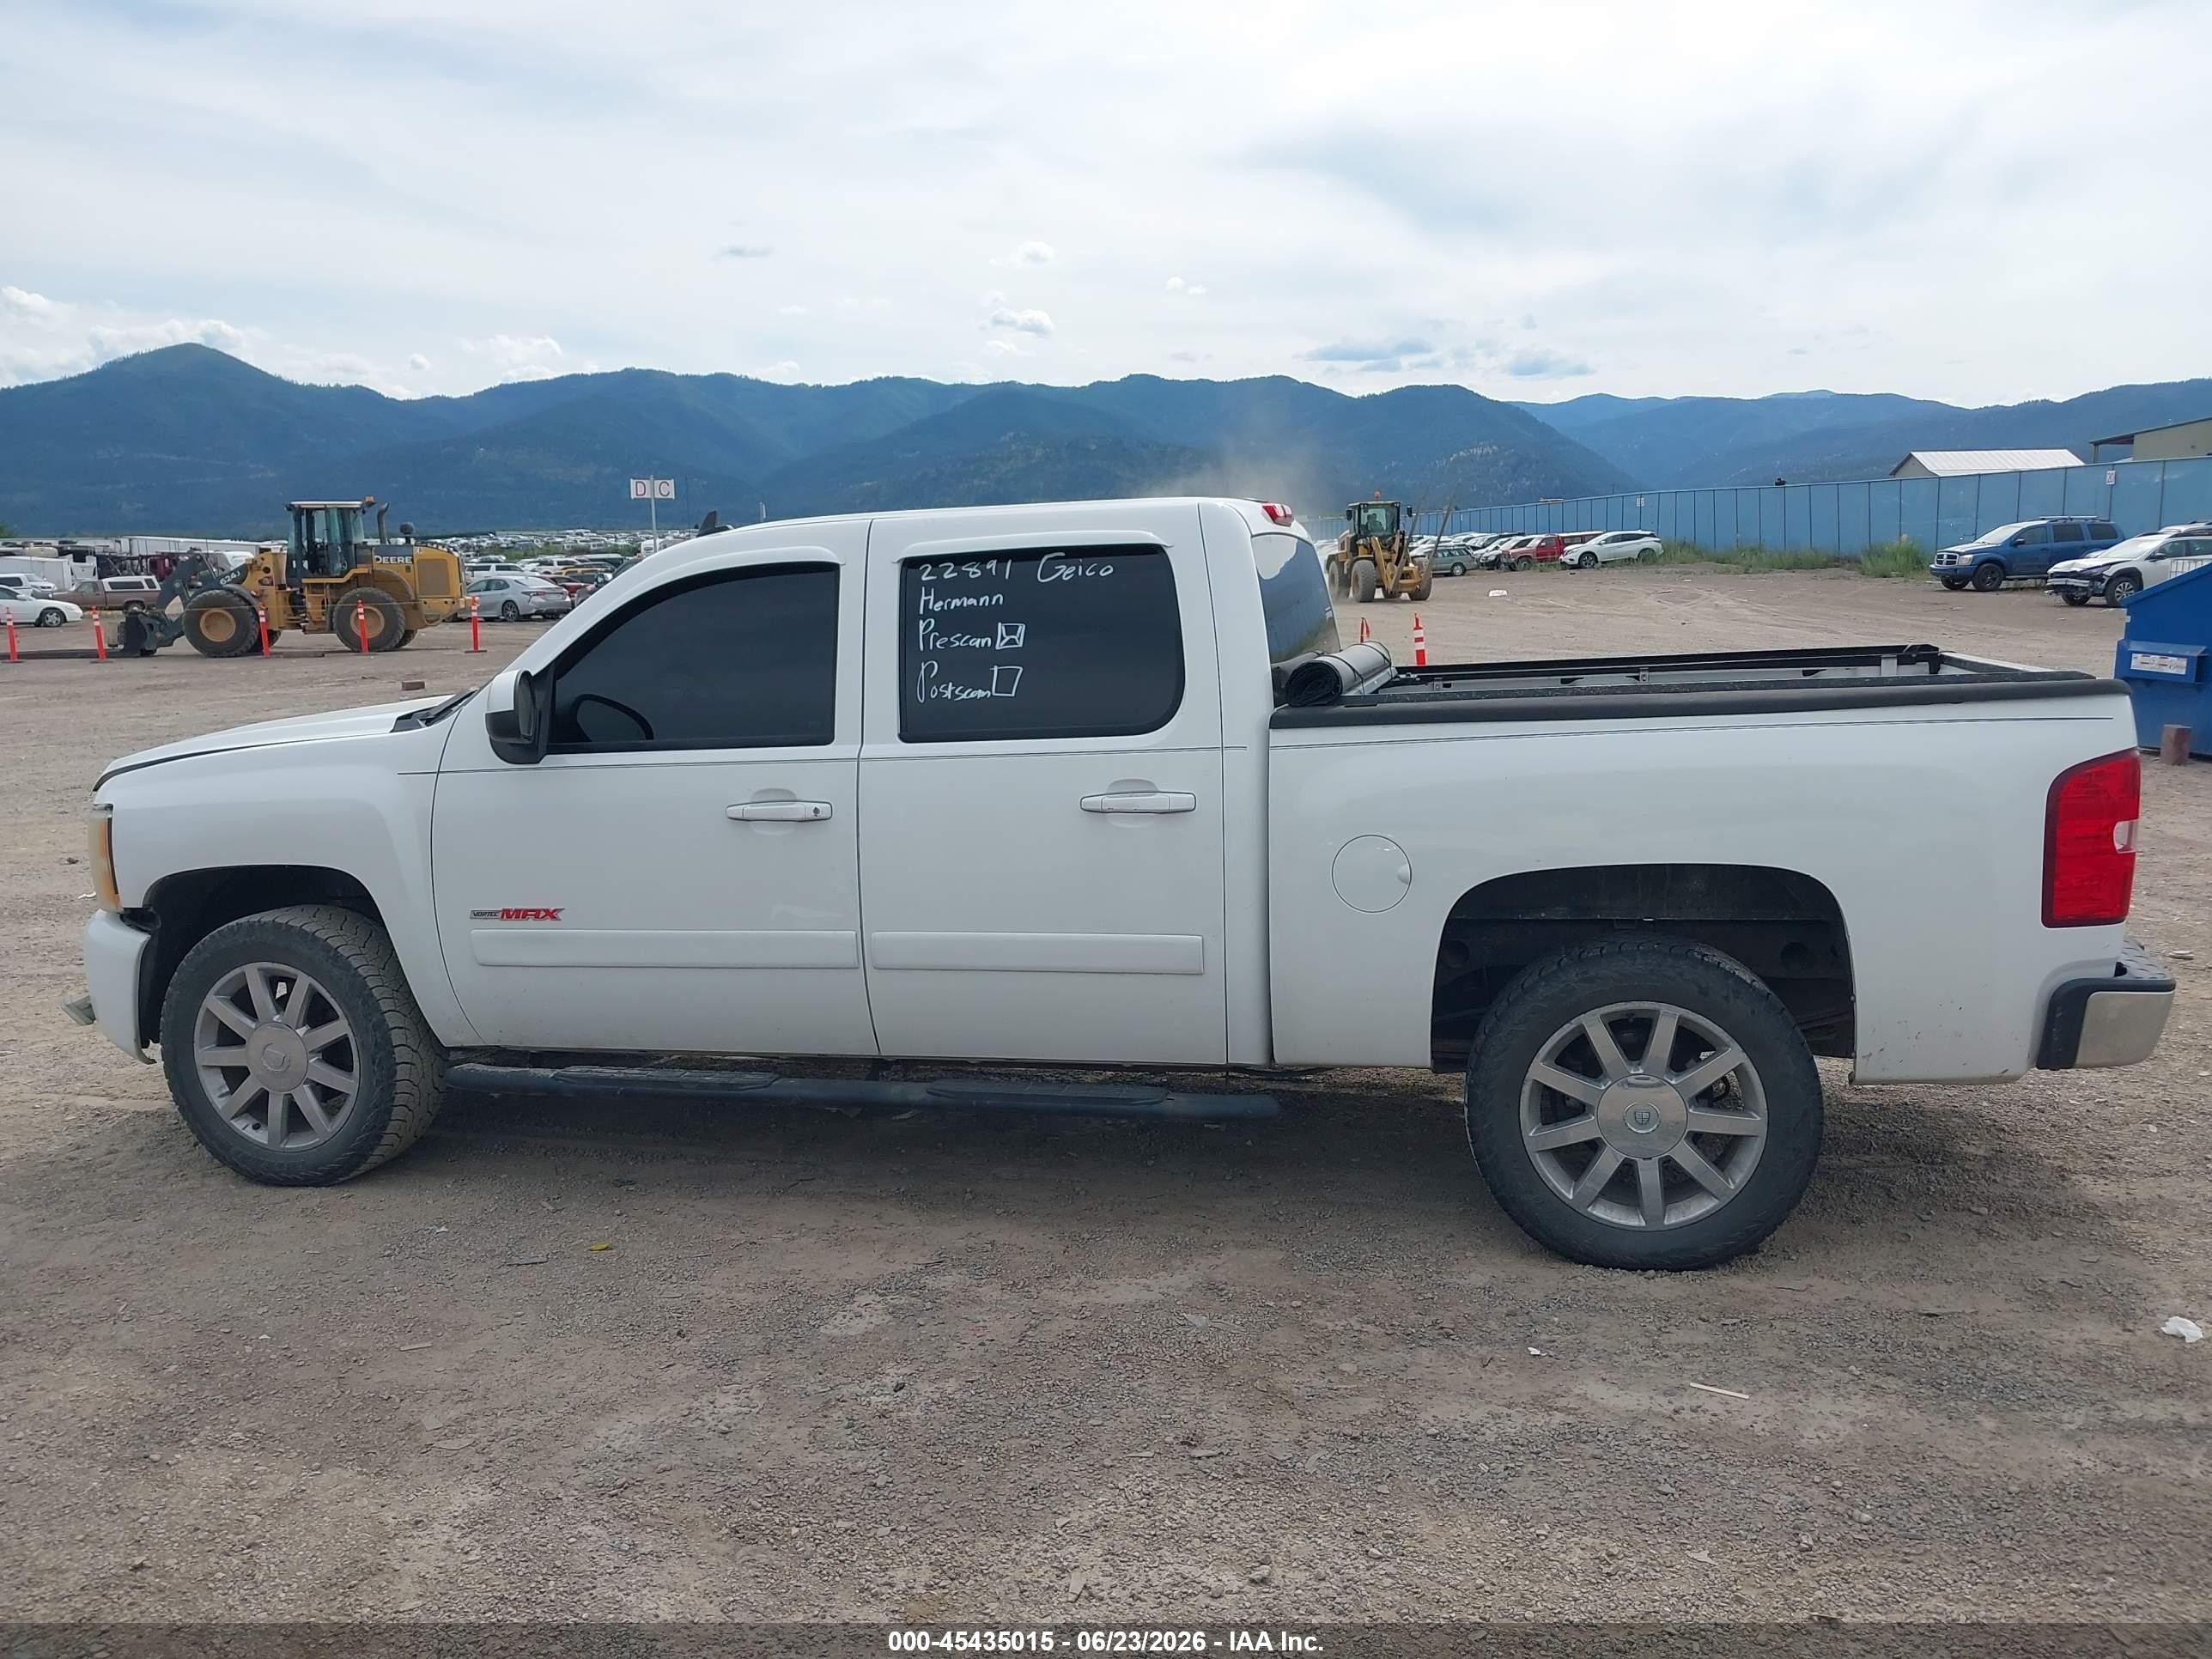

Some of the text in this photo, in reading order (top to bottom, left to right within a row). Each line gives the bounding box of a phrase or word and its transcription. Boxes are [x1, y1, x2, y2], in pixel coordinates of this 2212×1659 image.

[635, 481, 671, 497] D C
[374, 555, 412, 564] DEERE
[918, 552, 1115, 583] 22891 Geico
[220, 570, 240, 585] 624J
[918, 586, 1005, 615] Hermann
[918, 618, 992, 652] Prescan
[916, 660, 993, 704] Postscan
[501, 908, 563, 921] MAX
